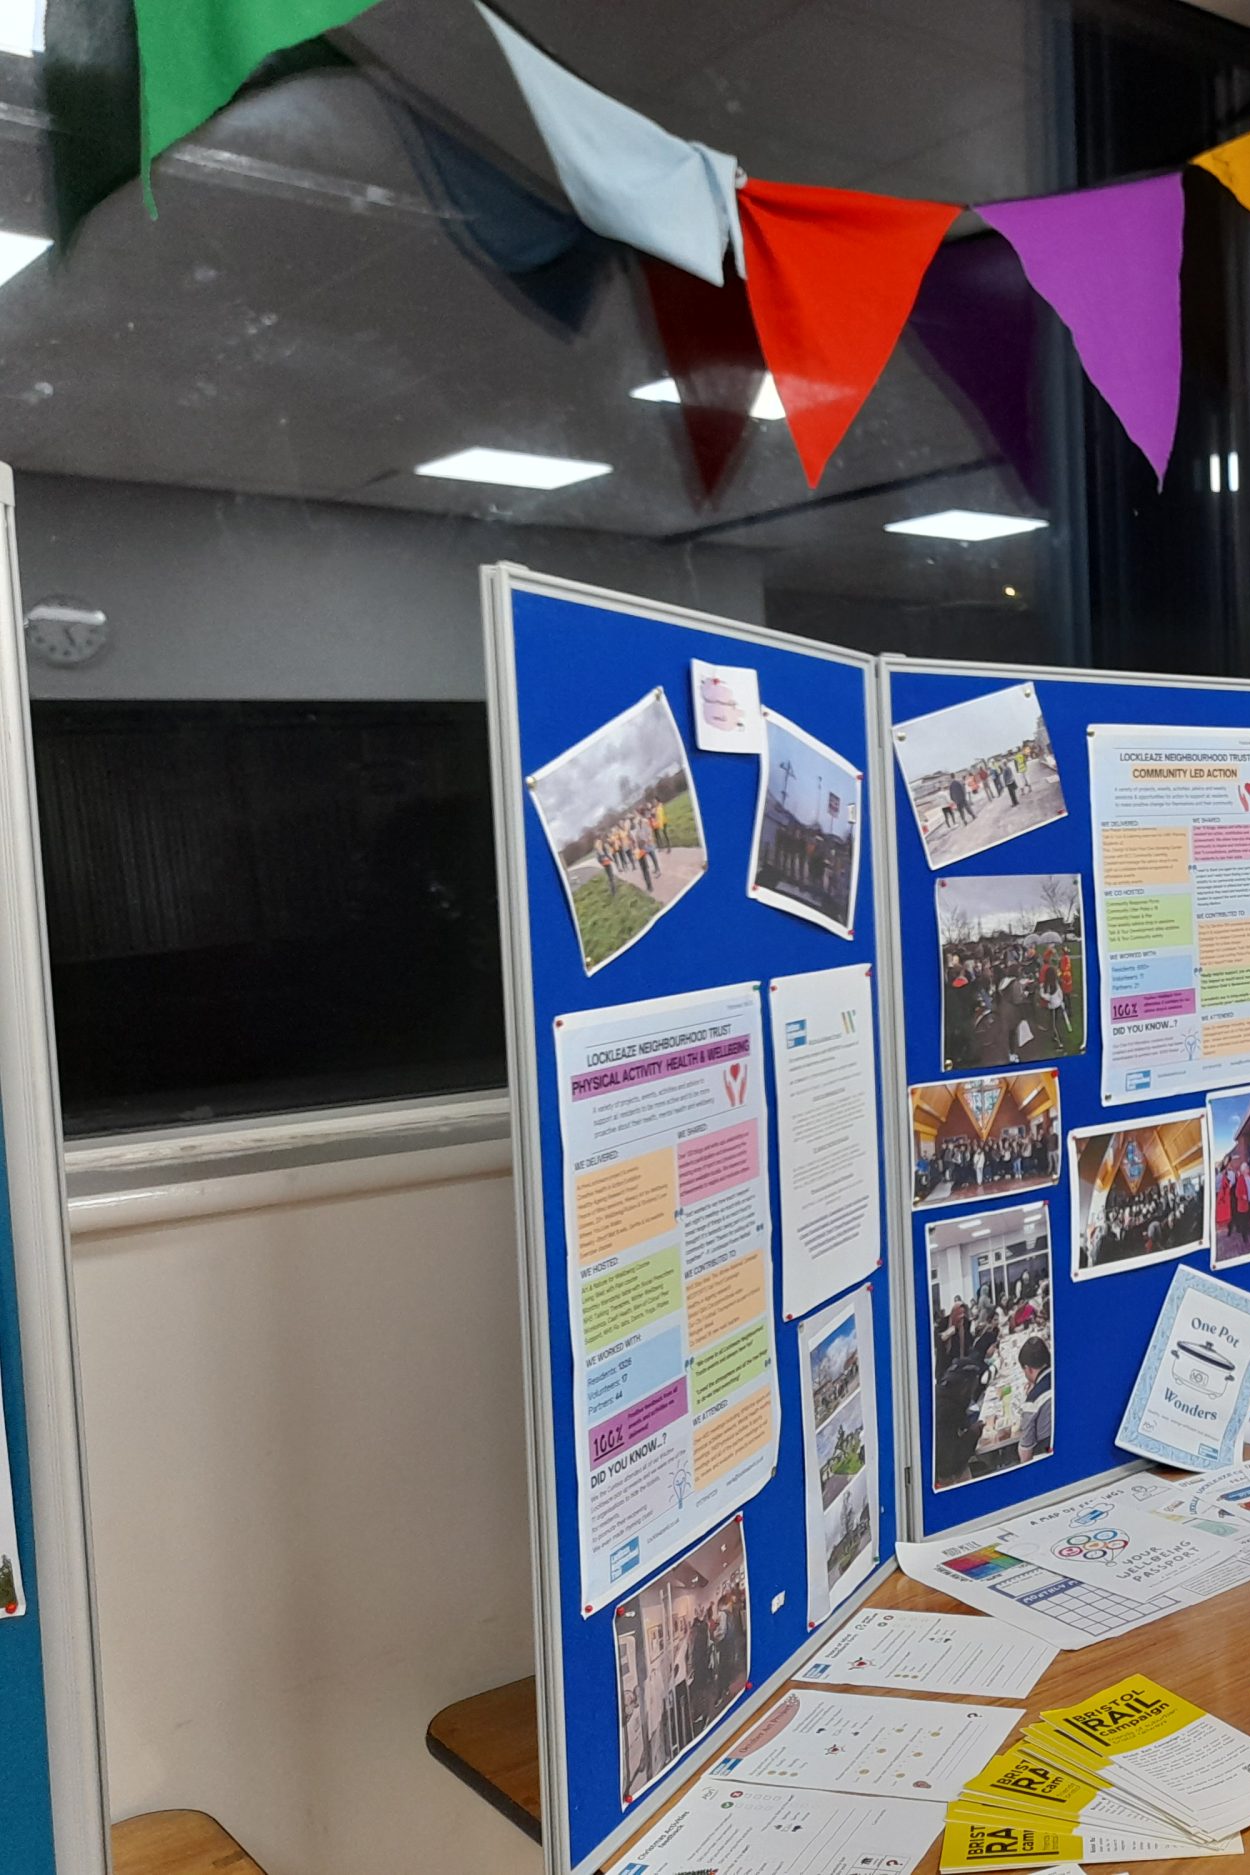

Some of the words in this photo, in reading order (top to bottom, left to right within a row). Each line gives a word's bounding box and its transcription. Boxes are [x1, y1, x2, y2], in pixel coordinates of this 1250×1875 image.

[1120, 753, 1162, 762] LOCKLEAZE
[1165, 753, 1228, 762] NEIGHBOURHOOD
[1229, 754, 1250, 762] TRUST
[1132, 768, 1188, 779] COMMUNITY
[1190, 768, 1205, 778] LED
[1207, 768, 1238, 778] ACTION
[1113, 1002, 1138, 1018] 100%
[586, 1045, 637, 1067] LOCKLEAZE
[638, 1030, 707, 1054] NEIGHBOURHOOD
[709, 1024, 732, 1039] TRUST
[1113, 1027, 1124, 1036] DID
[1126, 1025, 1144, 1034] YOU
[572, 1072, 621, 1096] PHYSICAL
[622, 1060, 663, 1083] ACTIVITY
[666, 1052, 698, 1072] HEALTH
[1191, 1317, 1217, 1335] One
[1218, 1326, 1241, 1349] Pot
[586, 1357, 597, 1368] WE
[598, 1342, 624, 1361] WORKED
[1163, 1387, 1218, 1421] Wonders
[594, 1424, 623, 1457] 100%
[591, 1470, 606, 1489] DID
[608, 1456, 628, 1477] YOU
[1040, 1512, 1060, 1523] MAP
[1116, 1540, 1192, 1579] WELLBEING
[1122, 1546, 1162, 1565] YOUR
[1133, 1547, 1200, 1583] PASSPORT
[1072, 1689, 1145, 1722] BRISTOL
[1080, 1697, 1162, 1731] RAIL
[1099, 1702, 1170, 1737] campaign
[996, 1759, 1031, 1785] BRIST
[1012, 1767, 1050, 1791] RA
[637, 1832, 667, 1861] Christmas
[968, 1825, 985, 1855] BRIST
[985, 1827, 1018, 1854] RA
